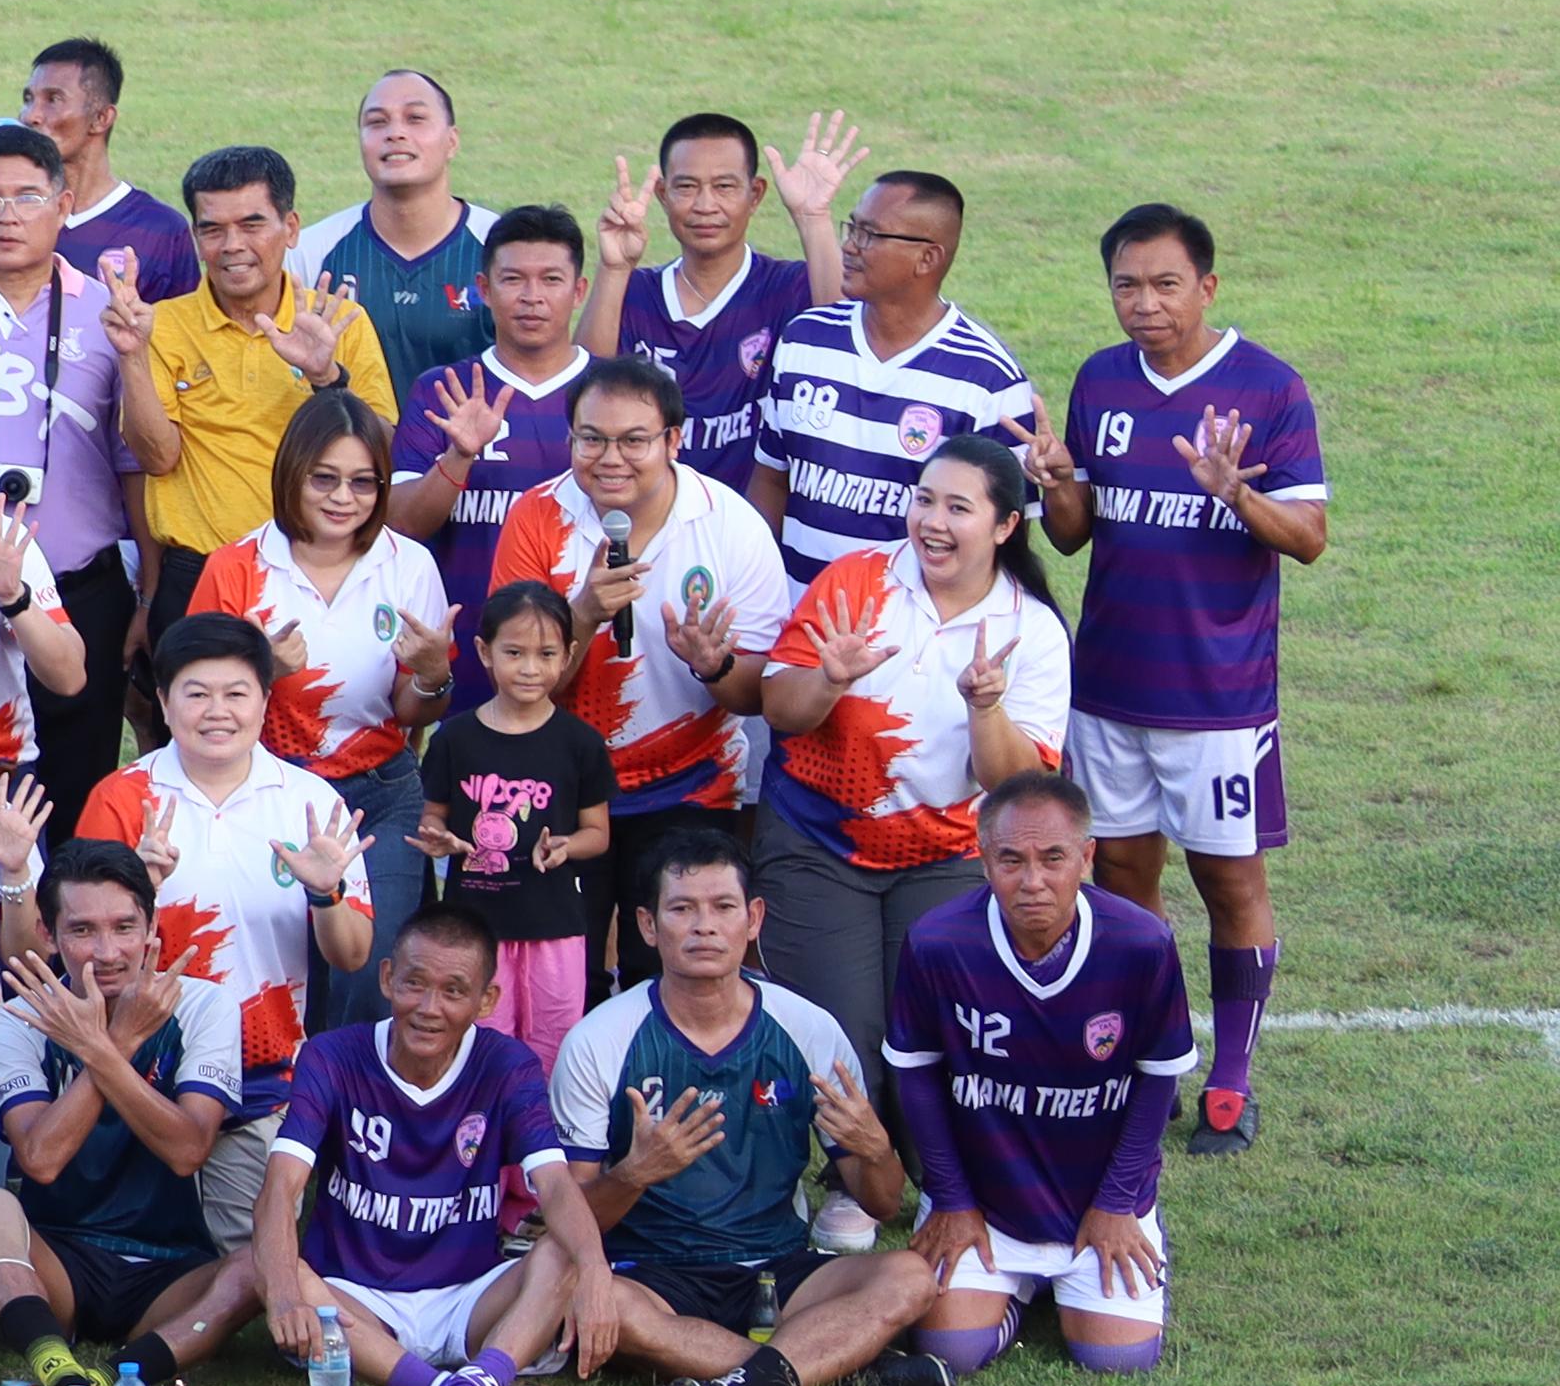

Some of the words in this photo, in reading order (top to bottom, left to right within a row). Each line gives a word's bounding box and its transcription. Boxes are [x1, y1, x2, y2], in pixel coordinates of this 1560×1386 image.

[792, 379, 840, 430] 88
[473, 418, 510, 461] 2
[1096, 409, 1134, 457] 19
[1145, 490, 1206, 529] TREE
[1212, 773, 1251, 820] 19
[955, 1002, 1012, 1058] 42
[1035, 1084, 1100, 1119] TREE
